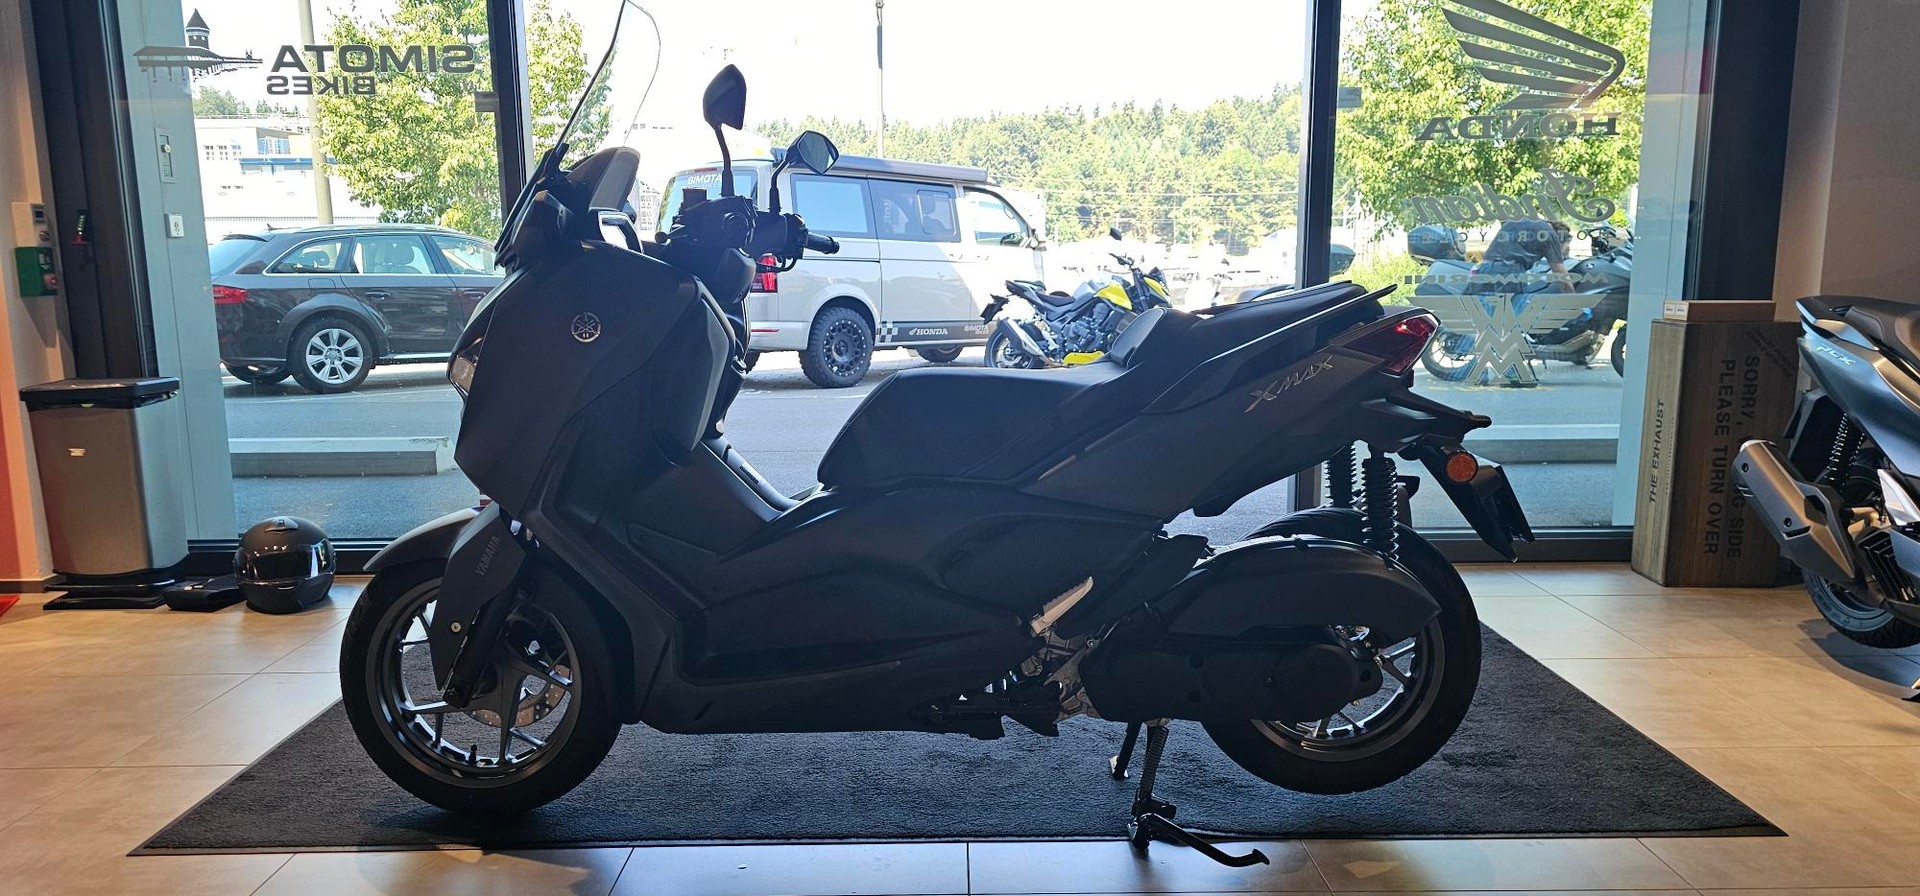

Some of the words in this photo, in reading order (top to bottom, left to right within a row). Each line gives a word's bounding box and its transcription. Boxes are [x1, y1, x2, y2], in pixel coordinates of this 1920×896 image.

[916, 328, 949, 336] HONDA
[1816, 343, 1856, 367] PCX
[1244, 354, 1335, 414] XMAX
[1715, 359, 1737, 436] PLEASE
[1735, 355, 1760, 426] SORRY,
[1652, 399, 1665, 470] EXHAUST
[1649, 474, 1658, 503] THE
[1709, 445, 1729, 494] TURN
[1704, 502, 1722, 555] OVER
[1726, 518, 1745, 559] SIDE
[475, 535, 501, 576] YAMAHA
